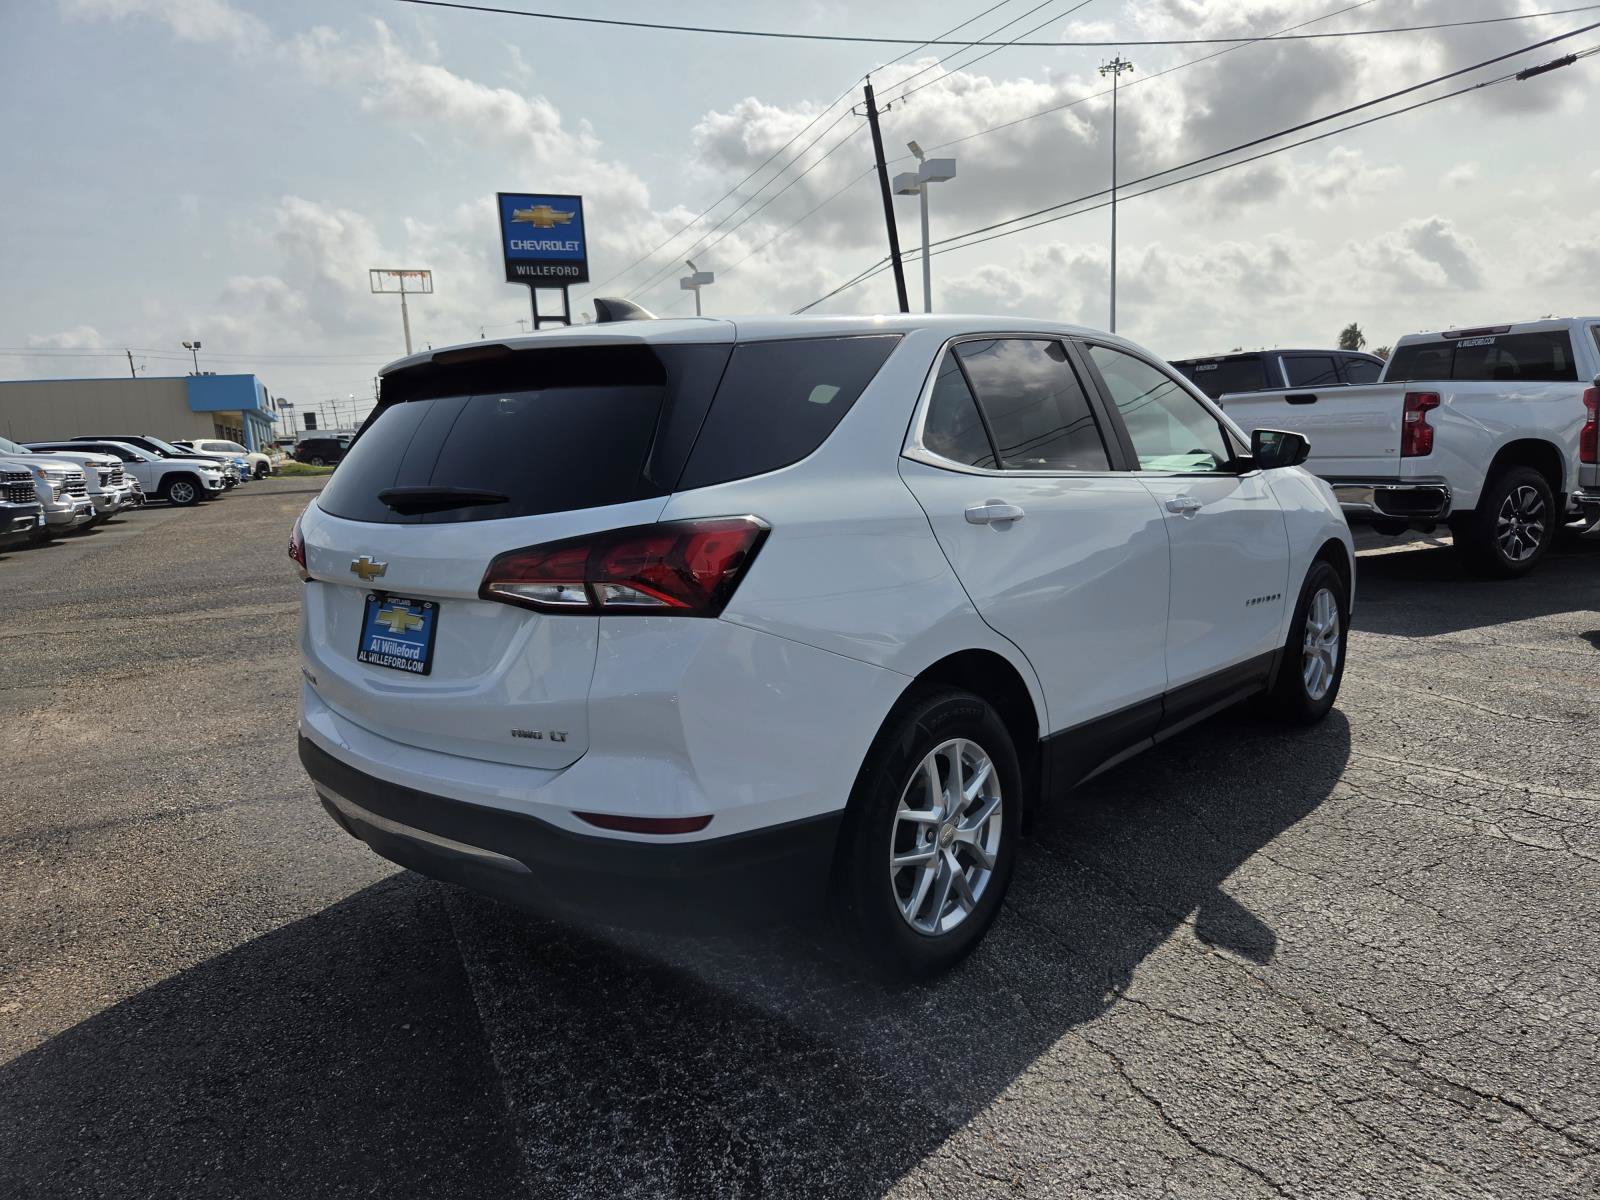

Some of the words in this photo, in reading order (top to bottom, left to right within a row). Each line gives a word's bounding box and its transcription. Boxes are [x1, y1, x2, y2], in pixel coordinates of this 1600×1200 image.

[510, 239, 580, 252] CHEVROLET
[516, 265, 579, 276] WILLEFORD
[370, 639, 380, 651] Al
[382, 640, 420, 659] Willeford
[359, 650, 368, 661] AL
[369, 652, 424, 673] WILLEFORD.COM
[550, 730, 569, 743] LT
